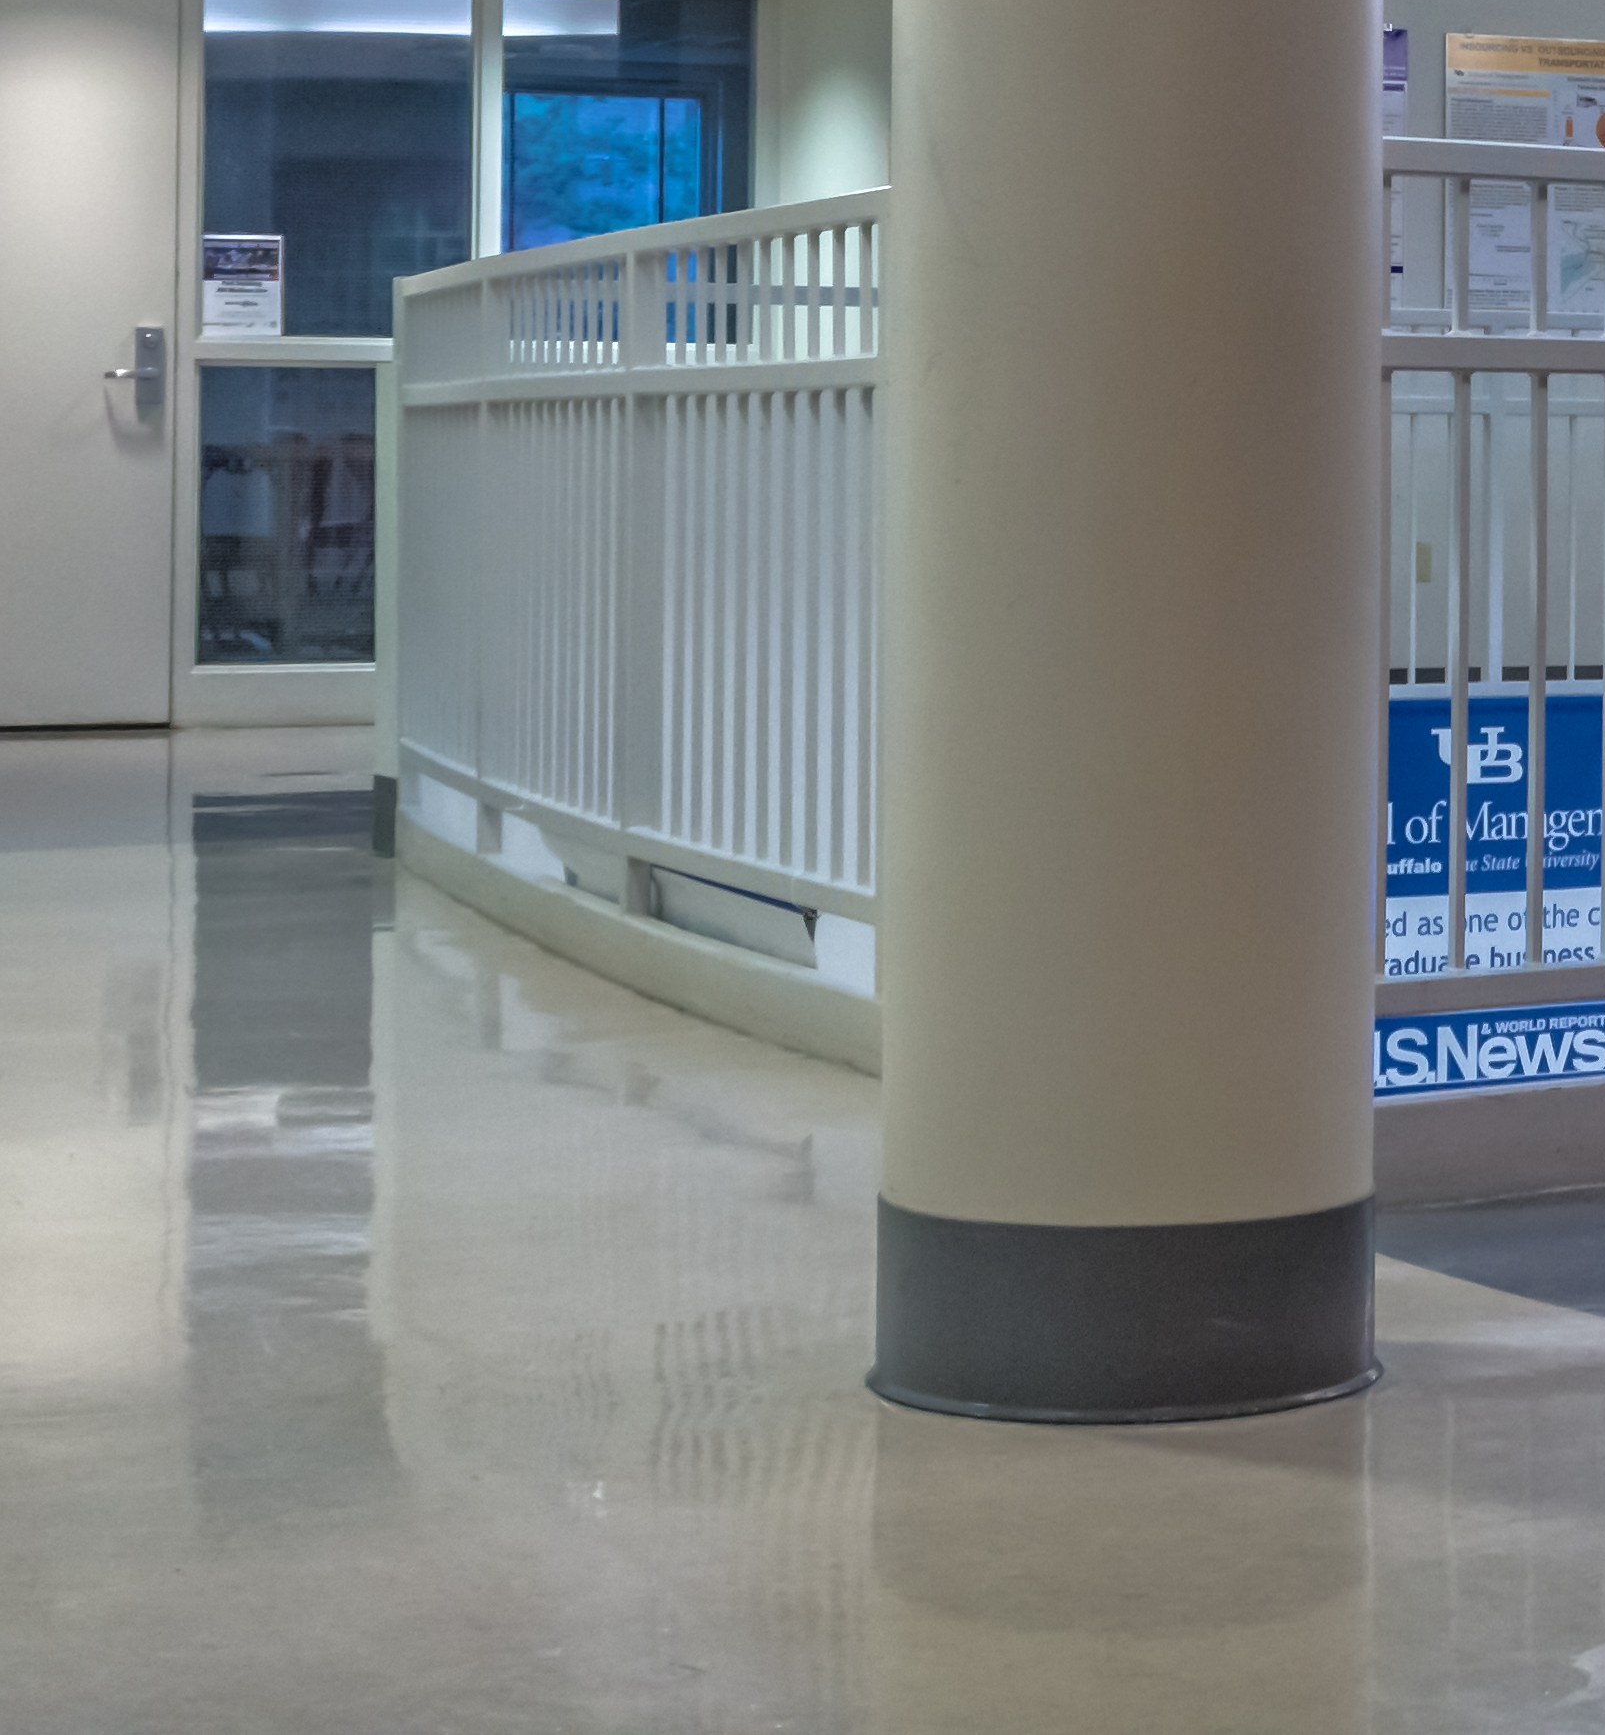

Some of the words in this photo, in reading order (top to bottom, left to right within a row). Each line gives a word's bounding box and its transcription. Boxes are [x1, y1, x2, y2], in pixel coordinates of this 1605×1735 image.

[1404, 799, 1447, 844] of
[1387, 857, 1443, 876] uffalo
[1481, 853, 1521, 872] State
[1417, 915, 1444, 937] as
[1464, 912, 1499, 934] ne
[1543, 903, 1580, 930] the
[1480, 1022, 1492, 1036] &
[1494, 1017, 1547, 1034] WORLD
